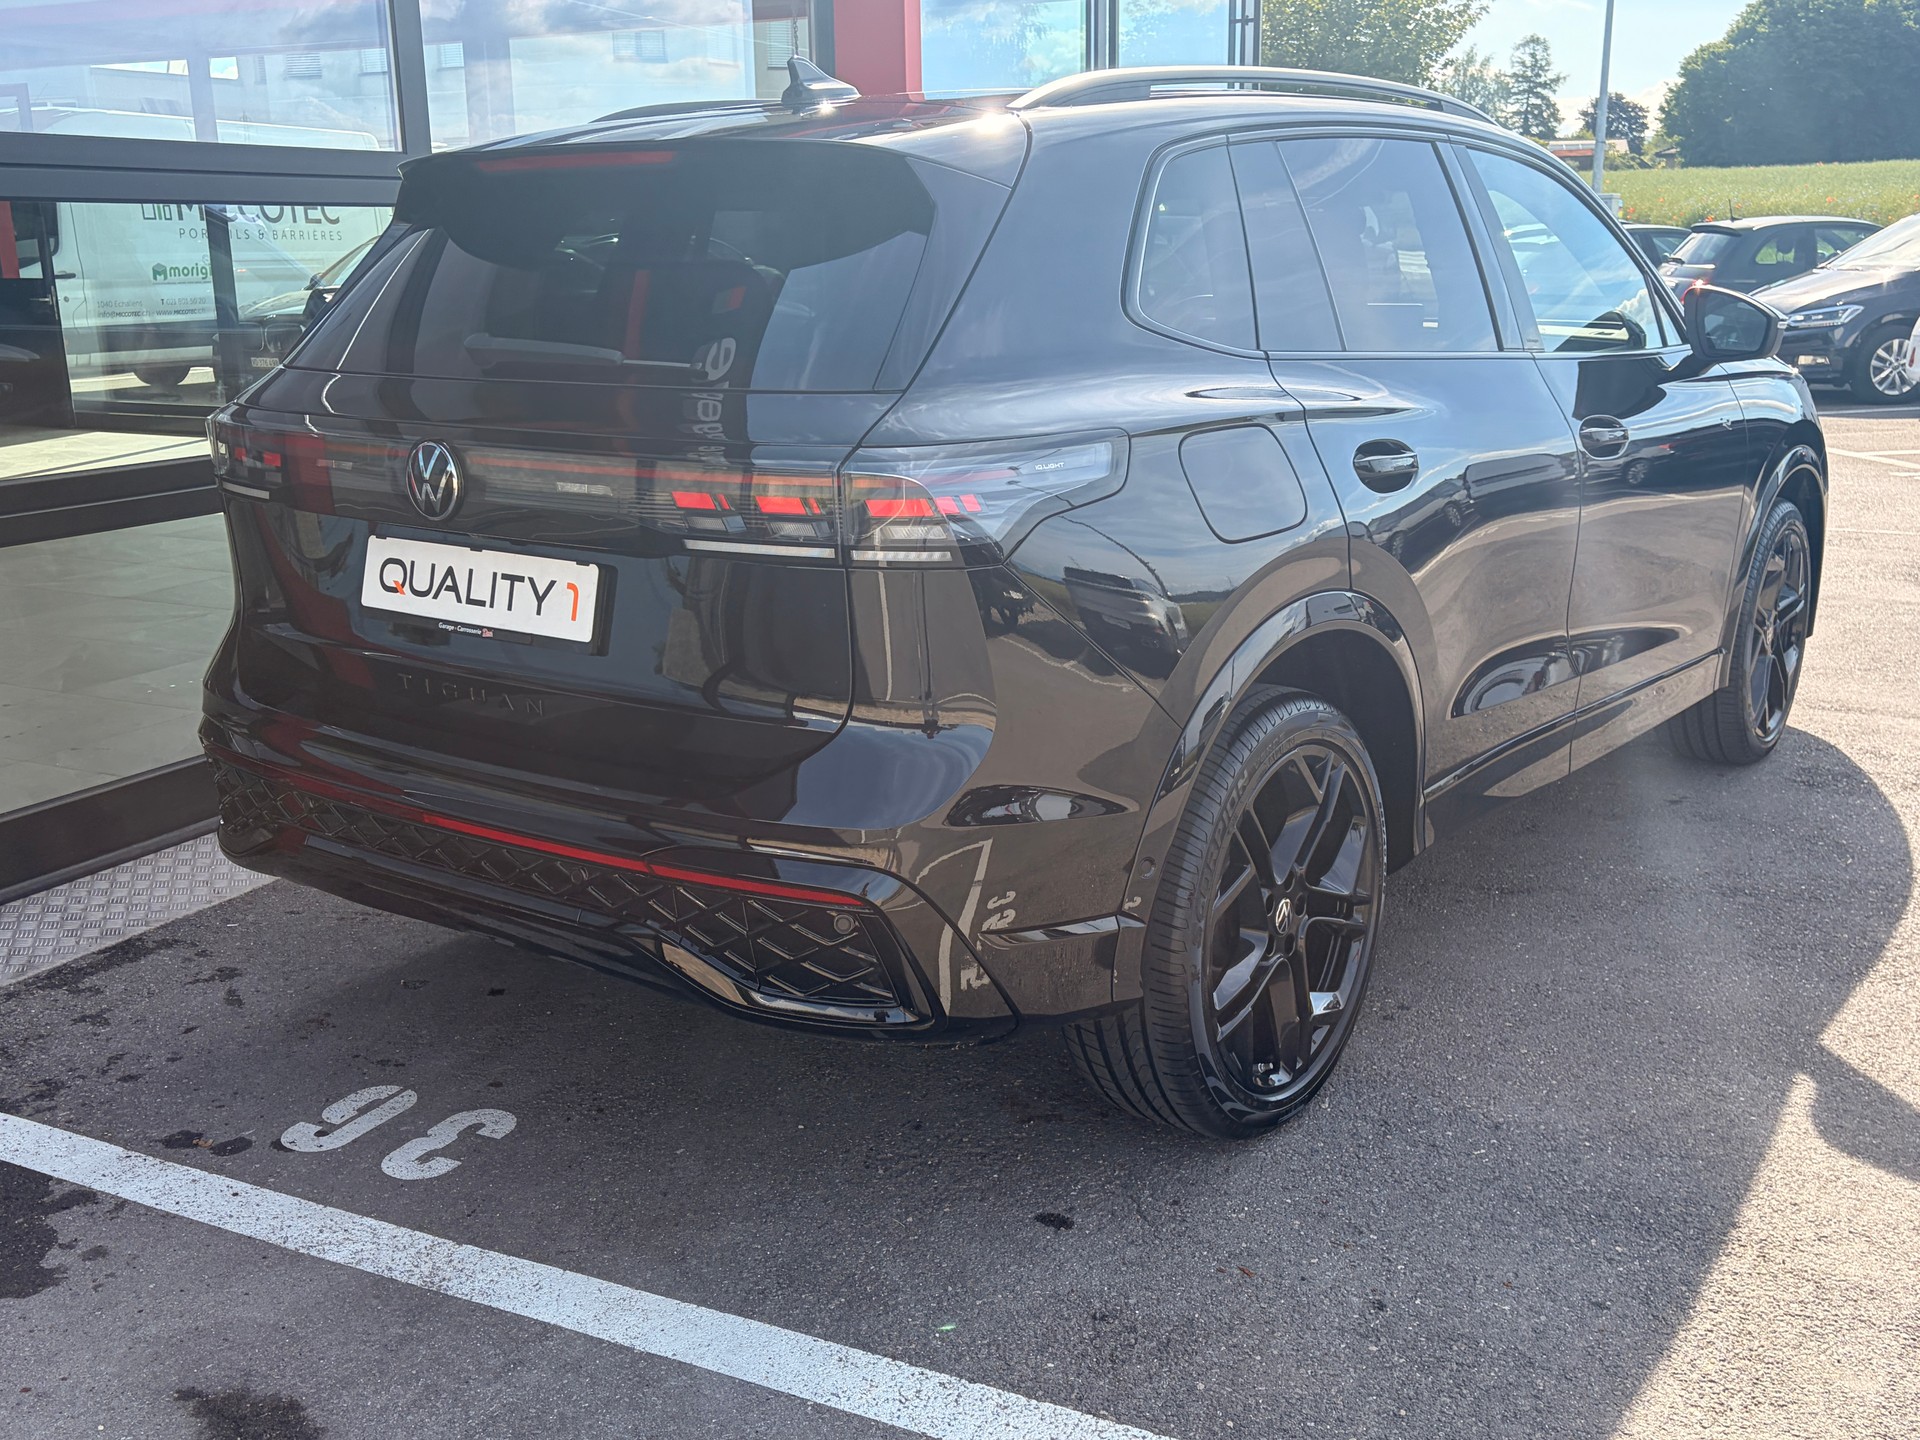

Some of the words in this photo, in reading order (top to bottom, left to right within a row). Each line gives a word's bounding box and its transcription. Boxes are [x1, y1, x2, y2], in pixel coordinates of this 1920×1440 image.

[179, 228, 250, 240] PORILS
[258, 229, 264, 240] &
[272, 228, 343, 241] BARRIÈRES
[398, 673, 543, 717] TIGUAN
